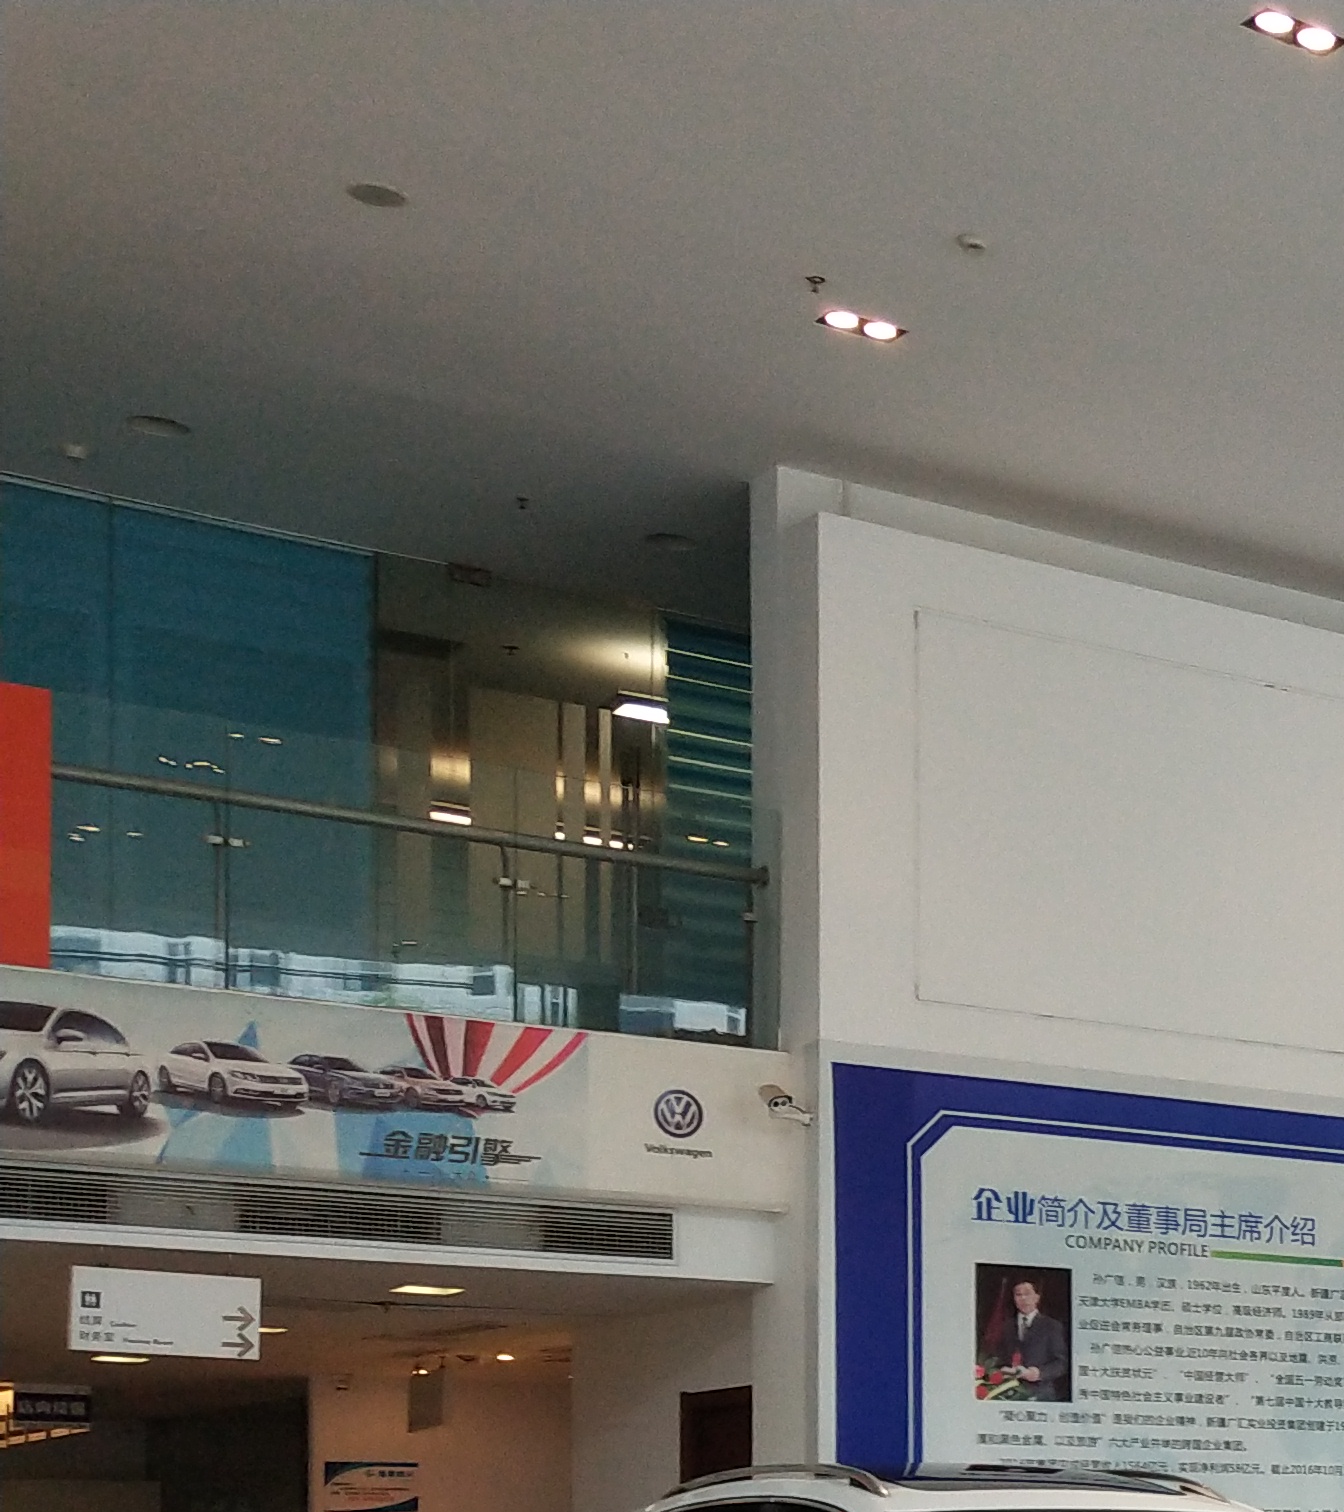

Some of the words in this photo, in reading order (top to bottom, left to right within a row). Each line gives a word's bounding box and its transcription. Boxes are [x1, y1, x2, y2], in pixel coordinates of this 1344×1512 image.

[380, 1130, 530, 1167] 金融引擎
[971, 1187, 1316, 1247] 企业简介及董事局主席介绍
[1065, 1233, 1145, 1255] COMPANY
[1148, 1240, 1209, 1258] PROFILE
